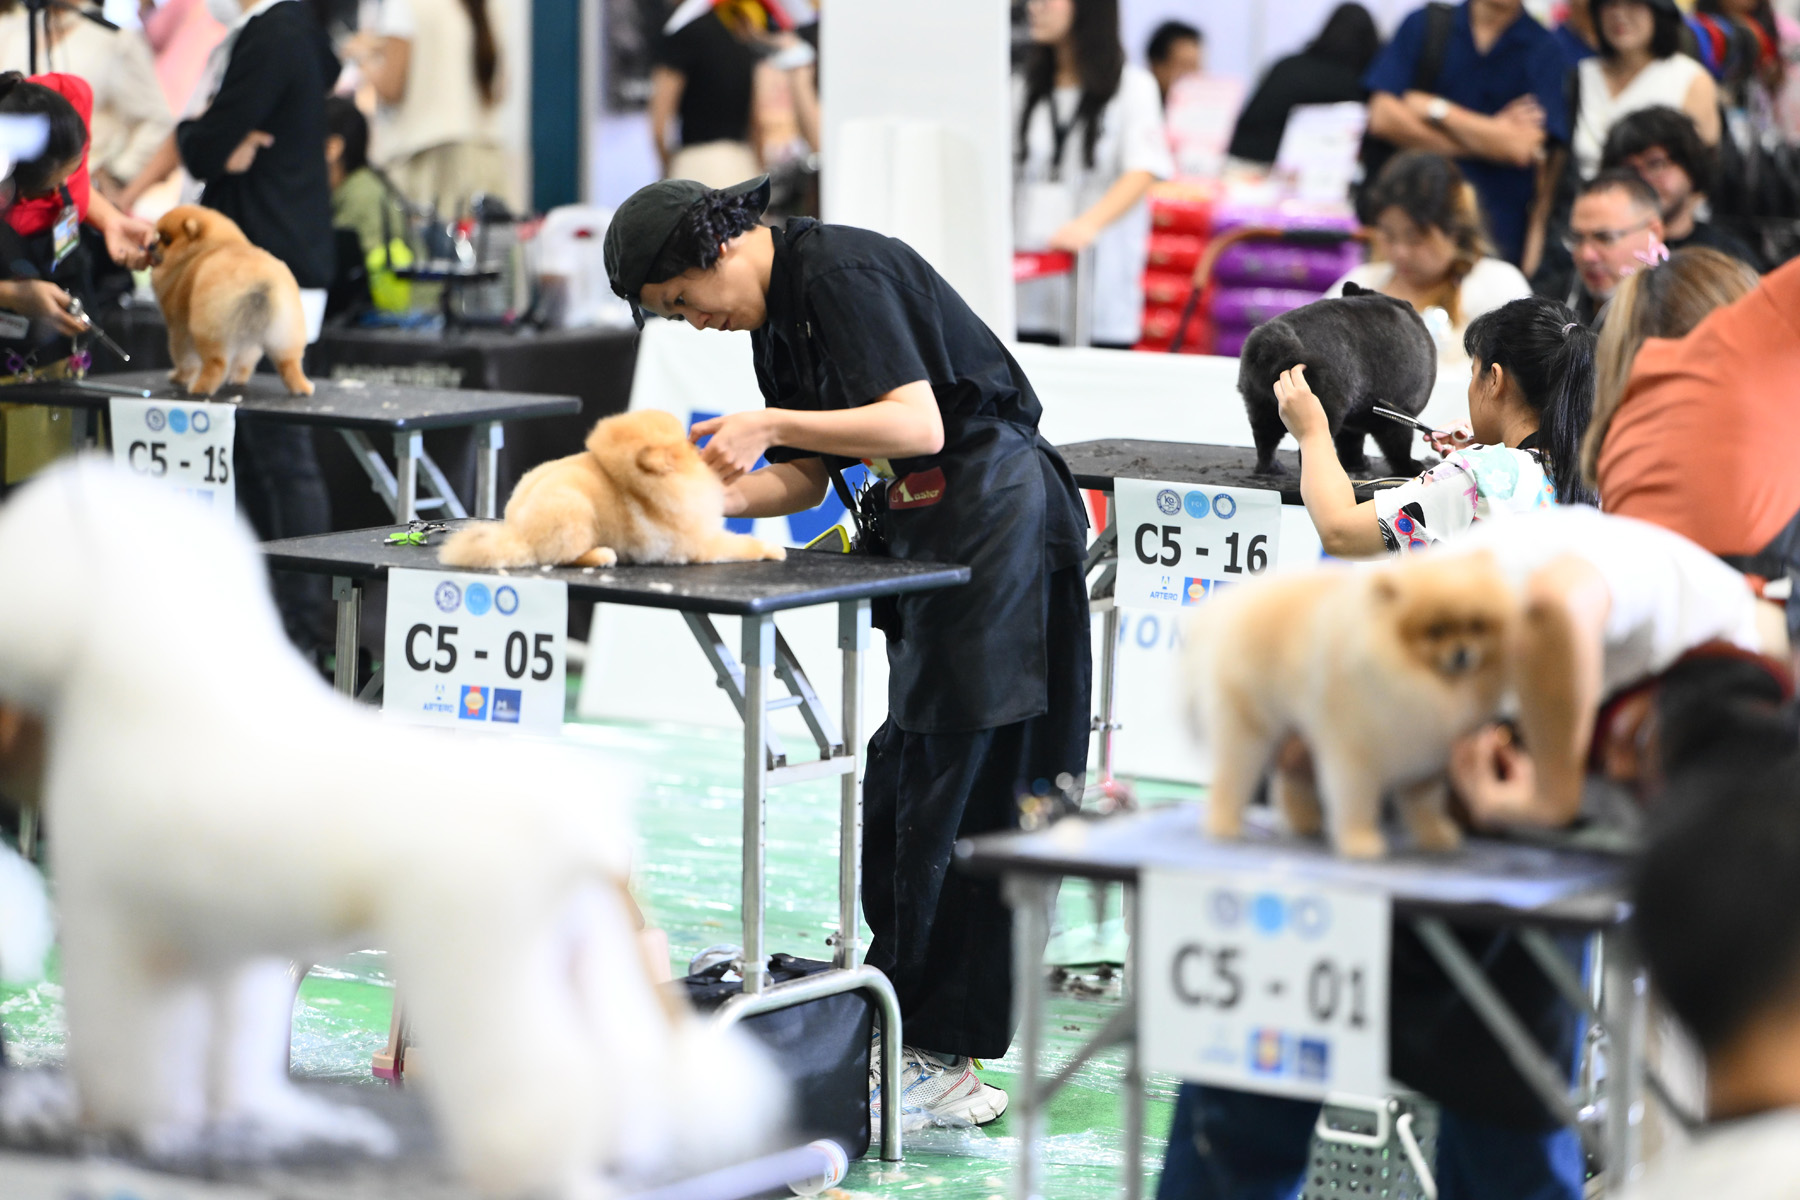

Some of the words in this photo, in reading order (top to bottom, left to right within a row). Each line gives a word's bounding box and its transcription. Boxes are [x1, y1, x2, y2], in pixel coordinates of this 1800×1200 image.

[129, 440, 168, 478] C5
[203, 445, 229, 484] 15
[1134, 523, 1182, 567] C5
[1223, 532, 1268, 577] 16
[1149, 591, 1178, 601] ARTERO
[405, 623, 458, 673] C5
[504, 630, 554, 681] 05
[1170, 942, 1244, 1011] C5
[1306, 957, 1368, 1029] 01
